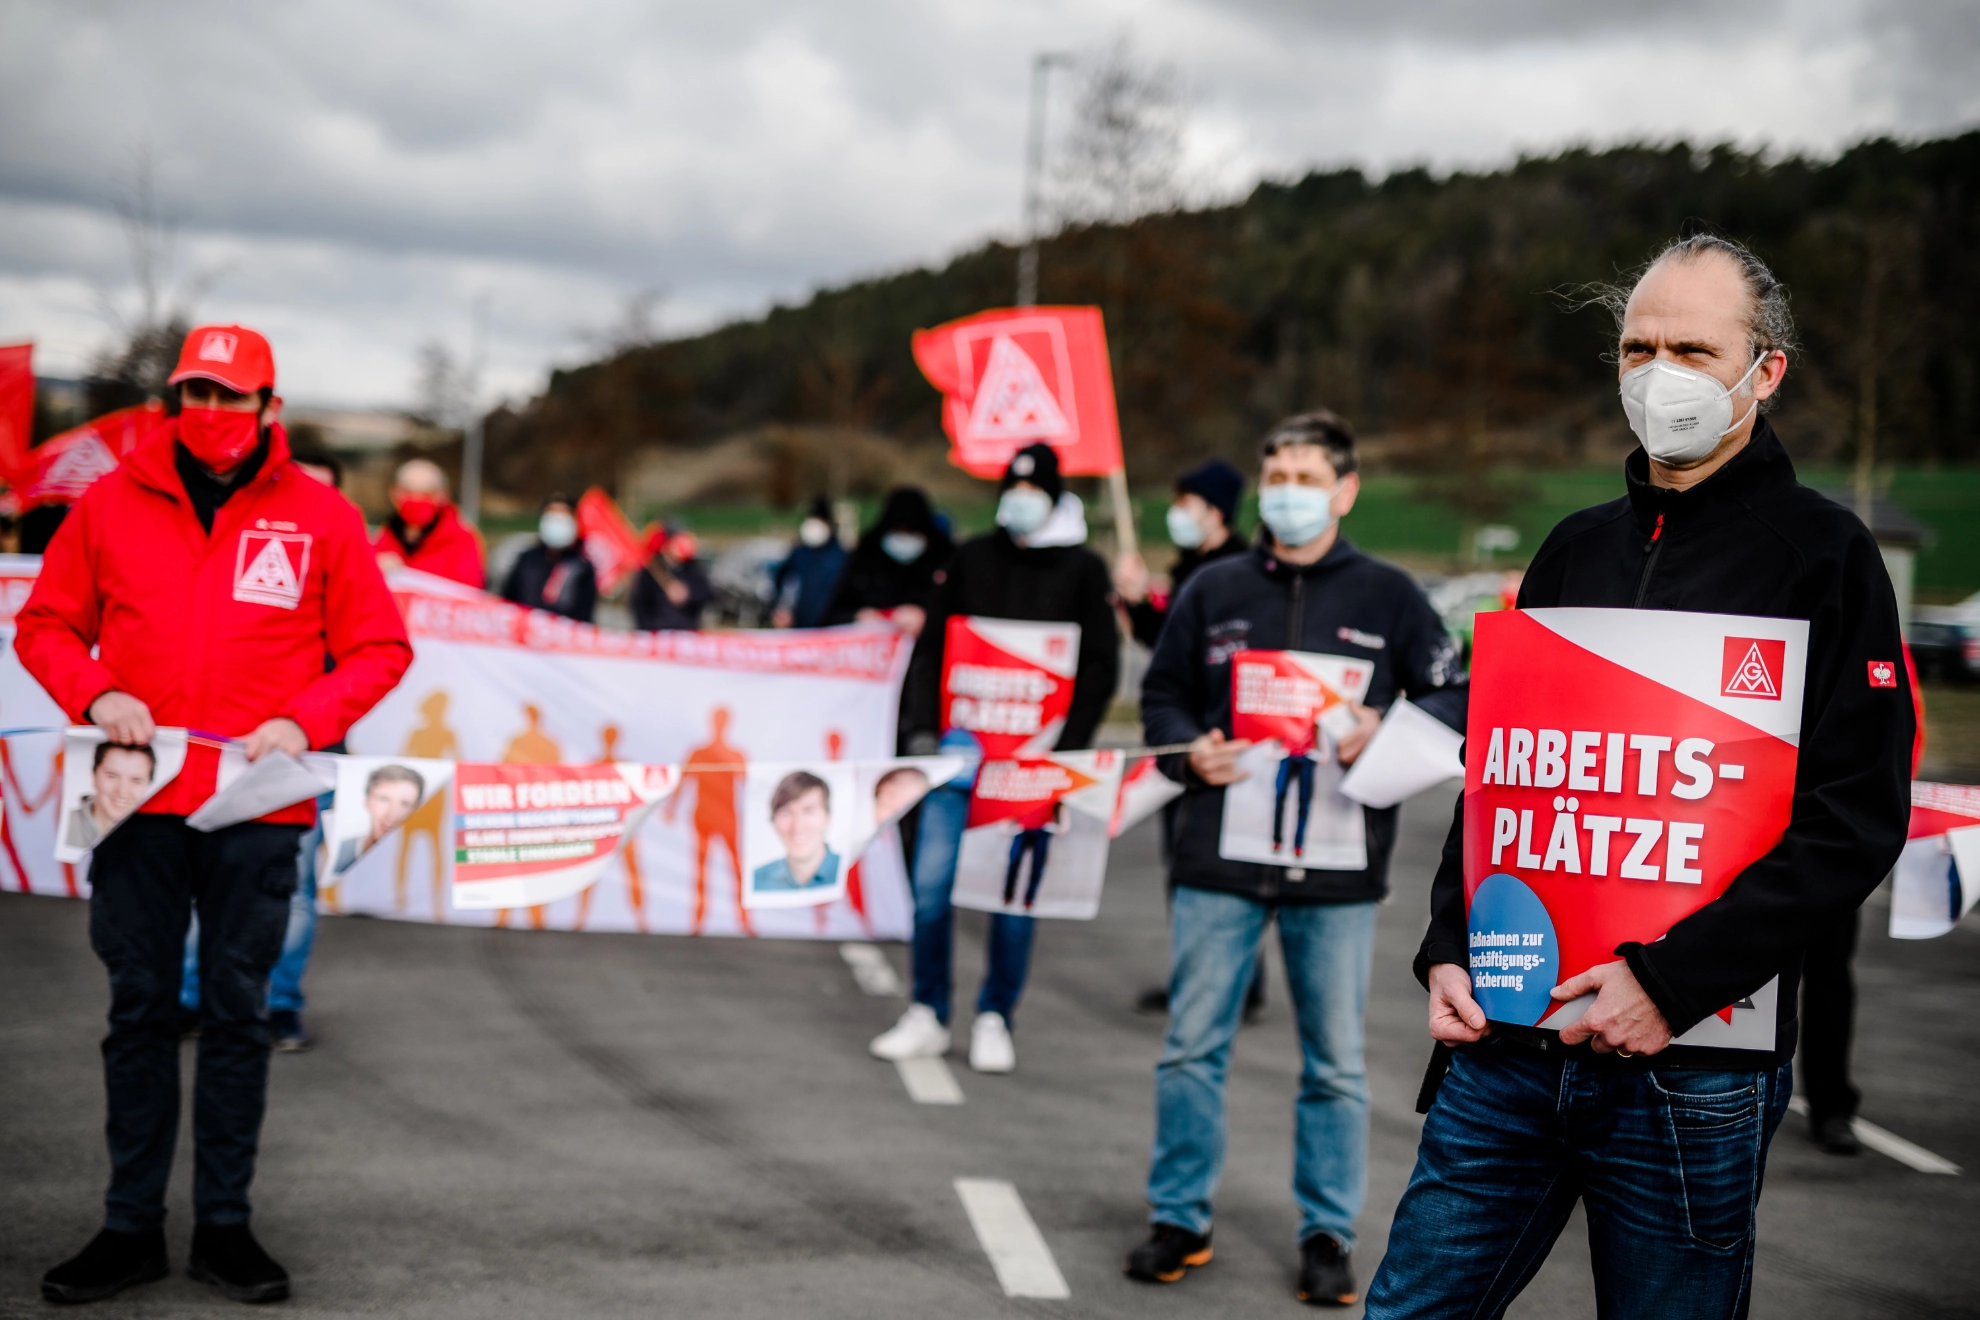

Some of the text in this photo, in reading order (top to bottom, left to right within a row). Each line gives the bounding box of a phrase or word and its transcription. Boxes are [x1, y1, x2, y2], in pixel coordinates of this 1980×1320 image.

[1482, 727, 1745, 800] ARBEITS-
[461, 779, 632, 810] WIR FORDERN
[1491, 796, 1705, 885] PLÄTZE
[1522, 933, 1544, 946] zur
[1475, 971, 1524, 992] sicherung
